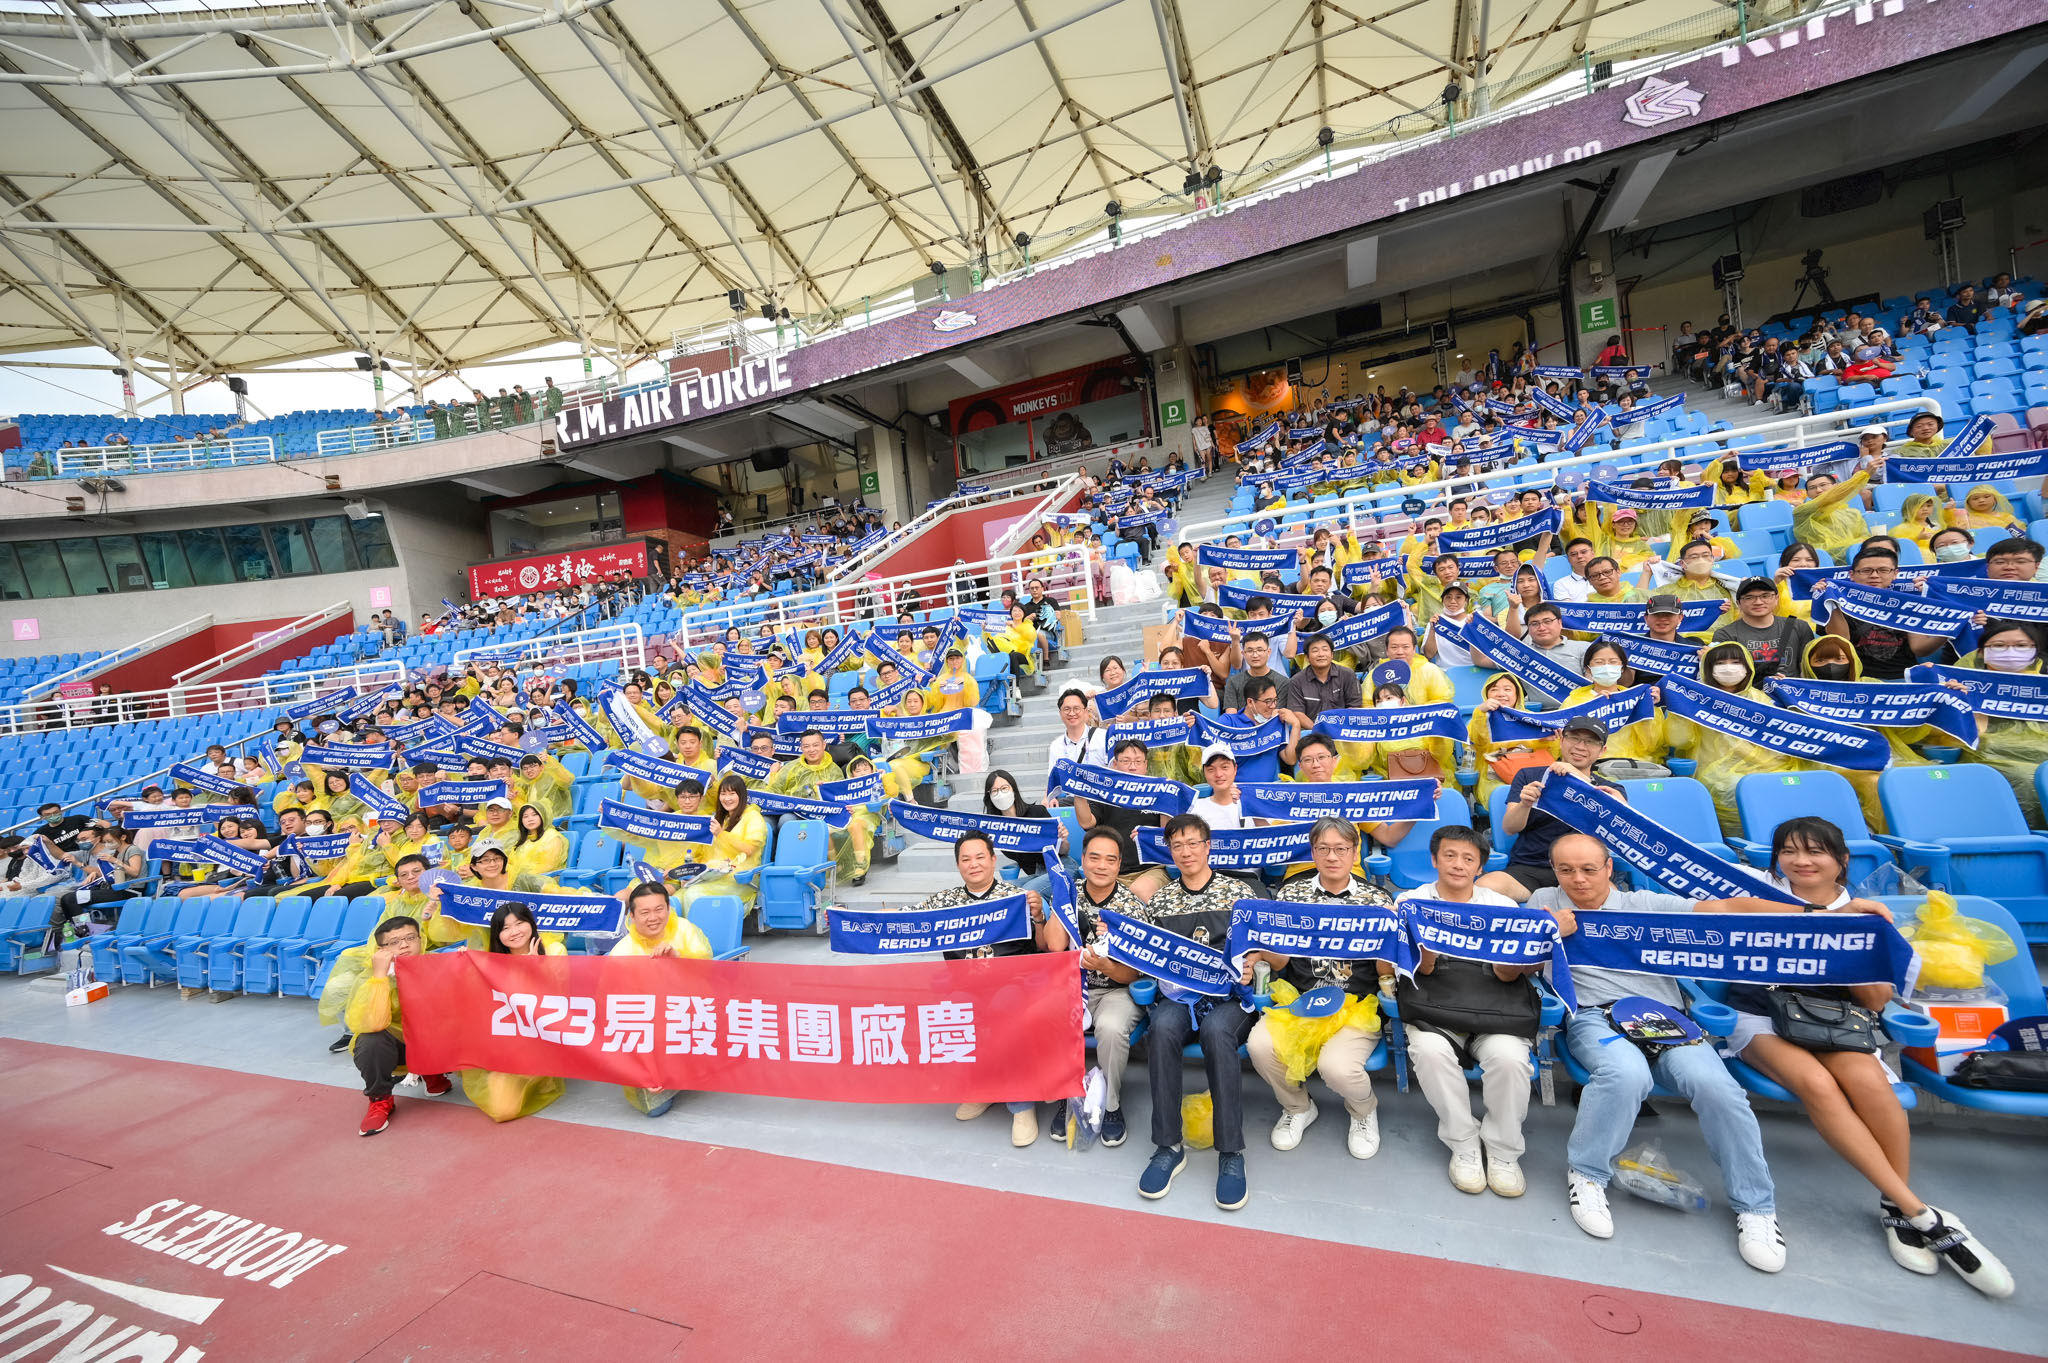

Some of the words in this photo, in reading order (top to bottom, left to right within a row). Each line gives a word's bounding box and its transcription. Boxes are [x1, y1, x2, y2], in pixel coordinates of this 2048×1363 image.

[1591, 305, 1604, 321] E
[623, 386, 674, 430] AIR
[680, 352, 792, 416] FORCE
[1013, 395, 1057, 416] MONKEYS
[1168, 405, 1178, 418] D
[1773, 454, 1799, 463] FIELD
[1800, 445, 1846, 459] FIGHTING!
[1815, 455, 1832, 464] GO!
[1900, 464, 1934, 472] EASY
[1937, 463, 1974, 472] FIELD
[1976, 456, 2042, 470] FIGHTING!
[866, 477, 873, 487] C
[1928, 474, 1971, 482] READY
[1994, 470, 2019, 479] GO!
[1653, 492, 1700, 501] FIGHTING!
[1847, 589, 1900, 608] FIELD
[1947, 584, 1999, 598] EASY
[1560, 607, 1595, 618] EASY
[1597, 610, 1636, 619] FIELD
[21, 623, 32, 633] A
[1246, 617, 1289, 634] FIGHTING!
[1344, 612, 1390, 633] FIGHTING!
[1588, 621, 1633, 631] READY
[1895, 614, 1922, 626] TO
[1923, 620, 1960, 631] GO!
[1347, 632, 1359, 642] TO
[1361, 627, 1378, 638] GO!
[1477, 623, 1503, 644] EASY
[1501, 641, 1530, 663] FIELD
[1640, 644, 1681, 660] FIELD
[1490, 647, 1523, 672] READY
[1525, 669, 1539, 680] TO
[1537, 677, 1559, 693] GO!
[1628, 654, 1674, 672] READY
[1676, 665, 1696, 674] TO
[1149, 675, 1197, 687] FIGHTING!
[1809, 690, 1869, 704] FIELD
[1872, 691, 1973, 714] FIGHTING!
[925, 712, 962, 726] FIGHTING!
[1349, 715, 1387, 725] FIELD
[1390, 709, 1458, 724] FIGHTING!
[1665, 680, 1711, 705] EASY
[1713, 700, 1765, 724] FIELD
[1766, 717, 1869, 749] FIGHTING!
[1870, 708, 1899, 720] TO
[1901, 707, 1937, 719] GO!
[894, 730, 922, 738] READY
[1340, 728, 1386, 738] READY
[1390, 728, 1408, 737] TO
[1410, 721, 1434, 734] GO!
[1695, 710, 1758, 737] READY
[1761, 730, 1787, 746] TO
[1787, 740, 1826, 755] GO!
[622, 762, 653, 778] READY
[653, 773, 666, 783] TO
[655, 764, 699, 780] FIGHTING!
[1934, 769, 1944, 781] 9
[461, 785, 497, 793] FIGHTING!
[1075, 767, 1113, 787] FIELD
[1114, 780, 1180, 796] FIGHTING!
[1065, 779, 1109, 799] READY
[1112, 794, 1129, 806] TO
[1132, 796, 1157, 806] GO!
[1256, 788, 1295, 802] EASY
[1299, 792, 1343, 804] FIELD
[1346, 789, 1420, 802] FIGHTING!
[795, 803, 843, 814] FIGHTING!
[1289, 807, 1340, 818] READY
[1345, 808, 1364, 818] TO
[1368, 806, 1394, 818] GO!
[660, 820, 702, 831] FIGHTING!
[904, 810, 938, 823] EASY
[940, 815, 977, 827] FIELD
[979, 821, 1042, 834] FIGHTING!
[1563, 787, 1610, 819] EASY
[1610, 814, 1668, 857] FIELD
[626, 823, 658, 838] READY
[658, 830, 670, 839] TO
[671, 832, 687, 840] GO!
[998, 835, 1021, 845] GO!
[204, 848, 231, 863] READY
[1243, 854, 1262, 864] TO
[1266, 851, 1292, 864] GO!
[1595, 824, 1657, 871] READY
[1656, 867, 1690, 889] TO
[453, 894, 494, 908] EASY
[538, 904, 606, 914] FIGHTING!
[536, 917, 554, 925] TO
[556, 917, 581, 926] GO!
[841, 921, 882, 933] EASY
[887, 923, 932, 933] FIELD
[934, 909, 1008, 931] FIGHTING!
[1257, 912, 1314, 929] FIELD
[1421, 907, 1486, 931] FIELD
[879, 936, 932, 949] READY
[936, 934, 957, 946] TO
[959, 929, 985, 943] GO!
[1118, 922, 1148, 941] GO!
[1583, 922, 1643, 941] EASY
[1650, 927, 1723, 946] FIELD
[1729, 932, 1876, 951] FIGHTING!
[1148, 935, 1170, 951] TO
[1248, 930, 1312, 949] READY
[1318, 937, 1345, 950] TO
[1348, 938, 1384, 952] GO!
[1490, 940, 1521, 955] TO
[1104, 932, 1168, 968] FIGHTIN
[1641, 950, 1724, 969] READY
[1732, 955, 1768, 972] TO
[1777, 957, 1827, 976] GO!
[1169, 961, 1220, 984] FIELD
[490, 988, 976, 1066] 2023易發集團廠慶
[101, 1198, 348, 1289] MONKEYS
